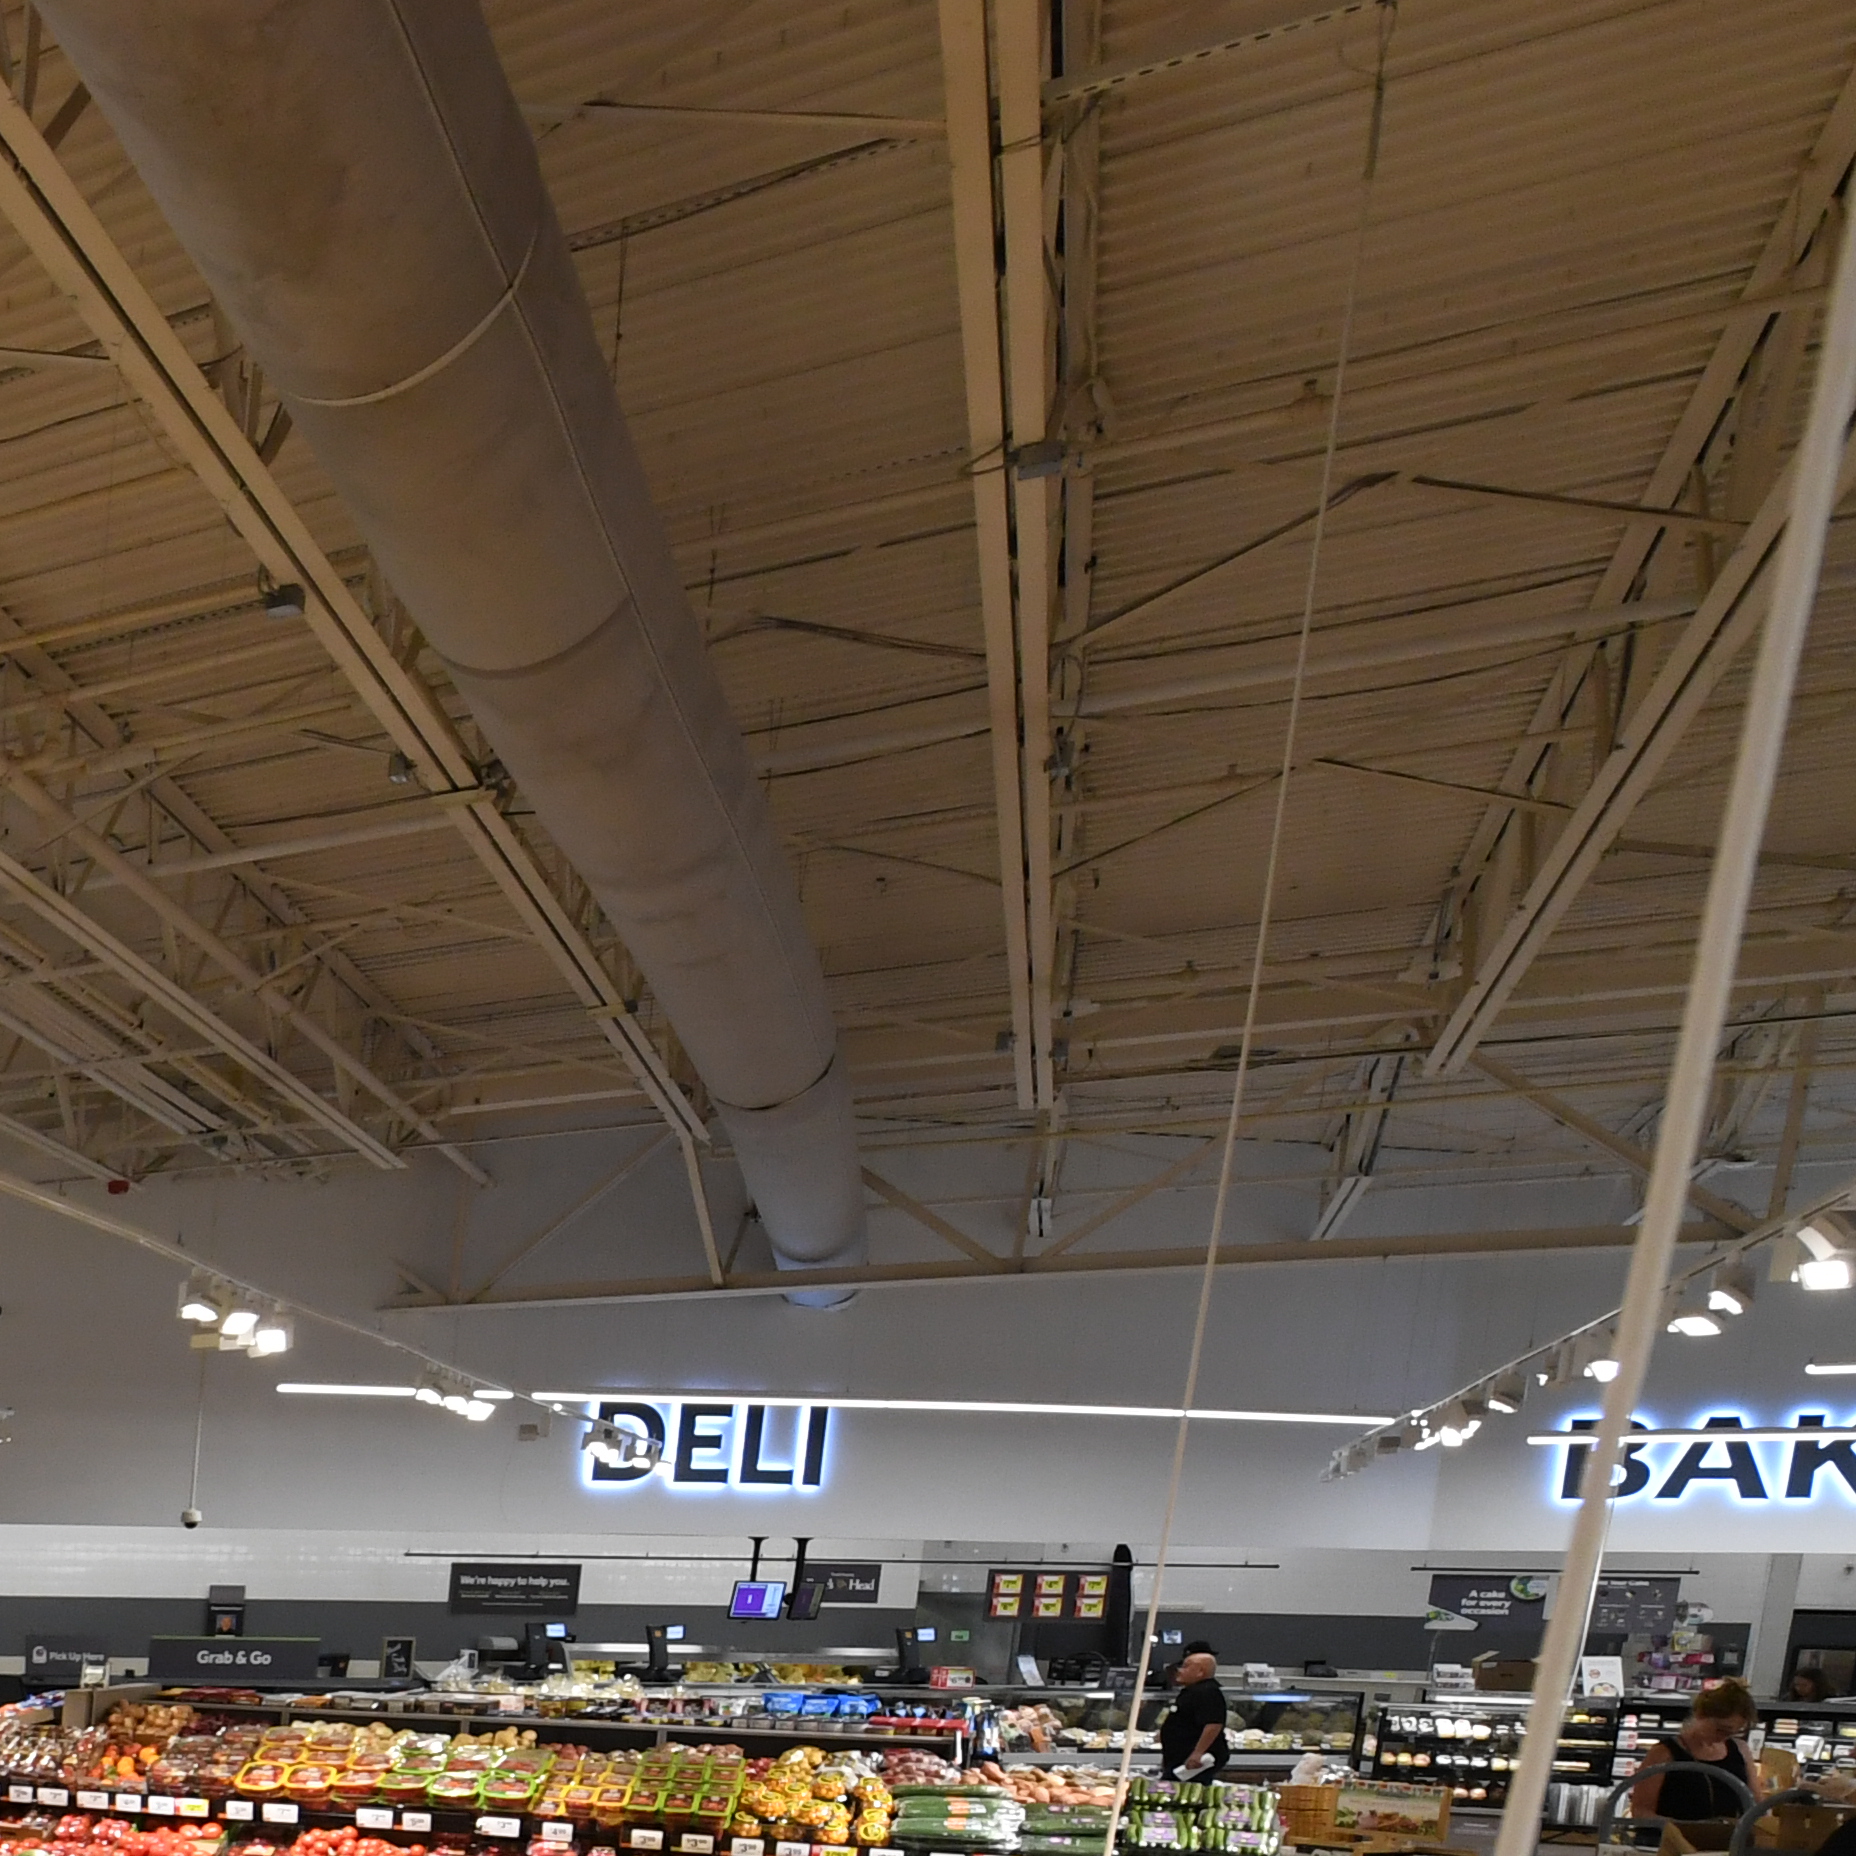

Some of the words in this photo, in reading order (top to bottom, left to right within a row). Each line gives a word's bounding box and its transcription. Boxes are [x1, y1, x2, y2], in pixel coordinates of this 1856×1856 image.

[591, 1401, 829, 1486] DELI
[49, 1651, 68, 1661] Pick
[69, 1652, 82, 1663] Up
[196, 1650, 232, 1664] Grab
[236, 1651, 246, 1664] &
[250, 1651, 272, 1665] Go
